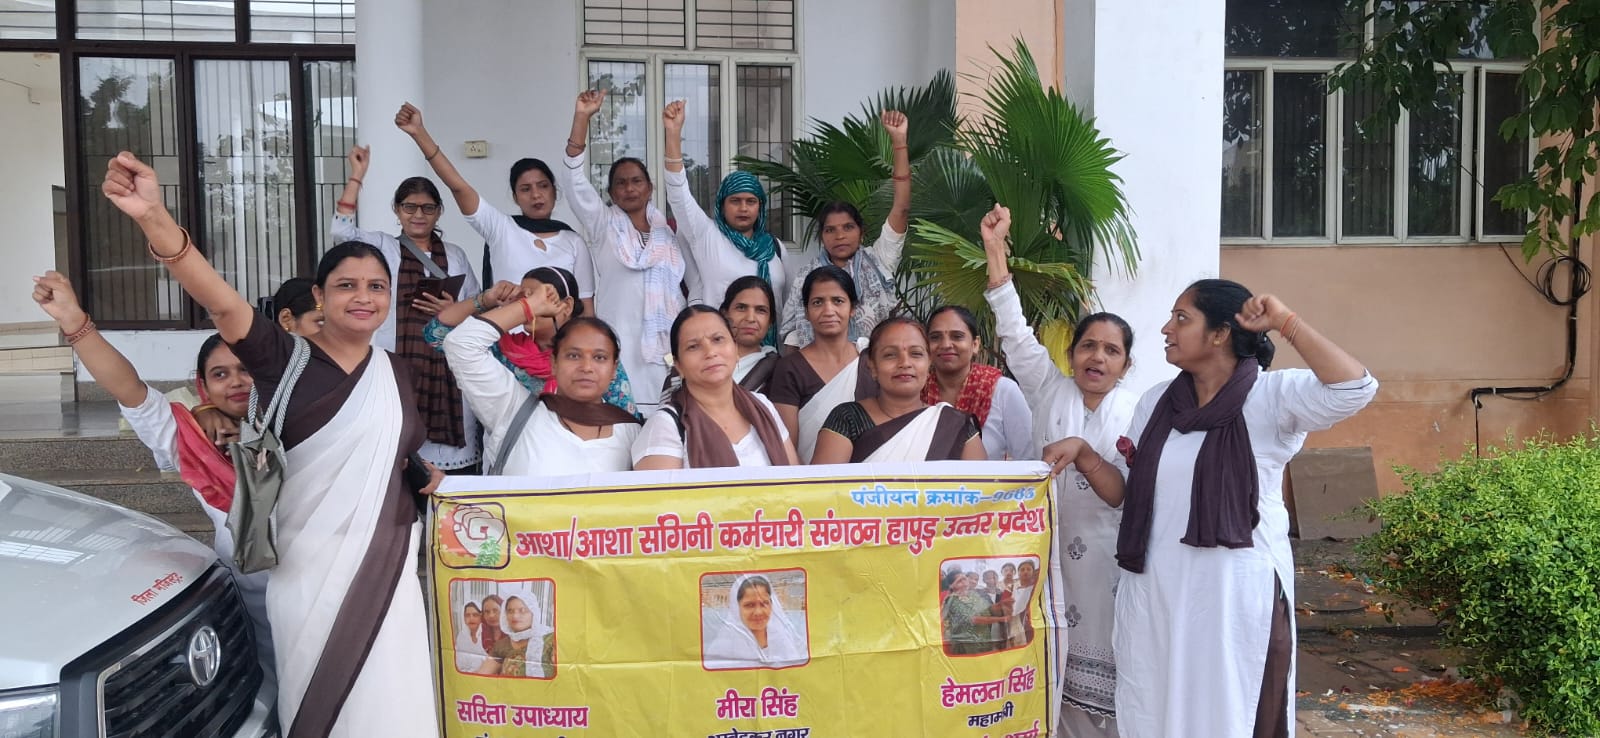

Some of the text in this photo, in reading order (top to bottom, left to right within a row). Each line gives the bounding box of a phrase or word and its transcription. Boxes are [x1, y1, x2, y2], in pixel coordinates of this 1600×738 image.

[851, 485, 918, 505] पंजीयन
[515, 516, 634, 561] आशा/आशा
[718, 508, 804, 548] कर्मचारी
[808, 509, 882, 547] संगठन
[943, 512, 995, 538] उत्तर
[997, 502, 1046, 538] प्रदेश
[716, 687, 800, 719] मीरा सिंह
[940, 665, 1036, 708] हेमलता सिंह
[456, 694, 589, 728] सरिता उपाध्याय
